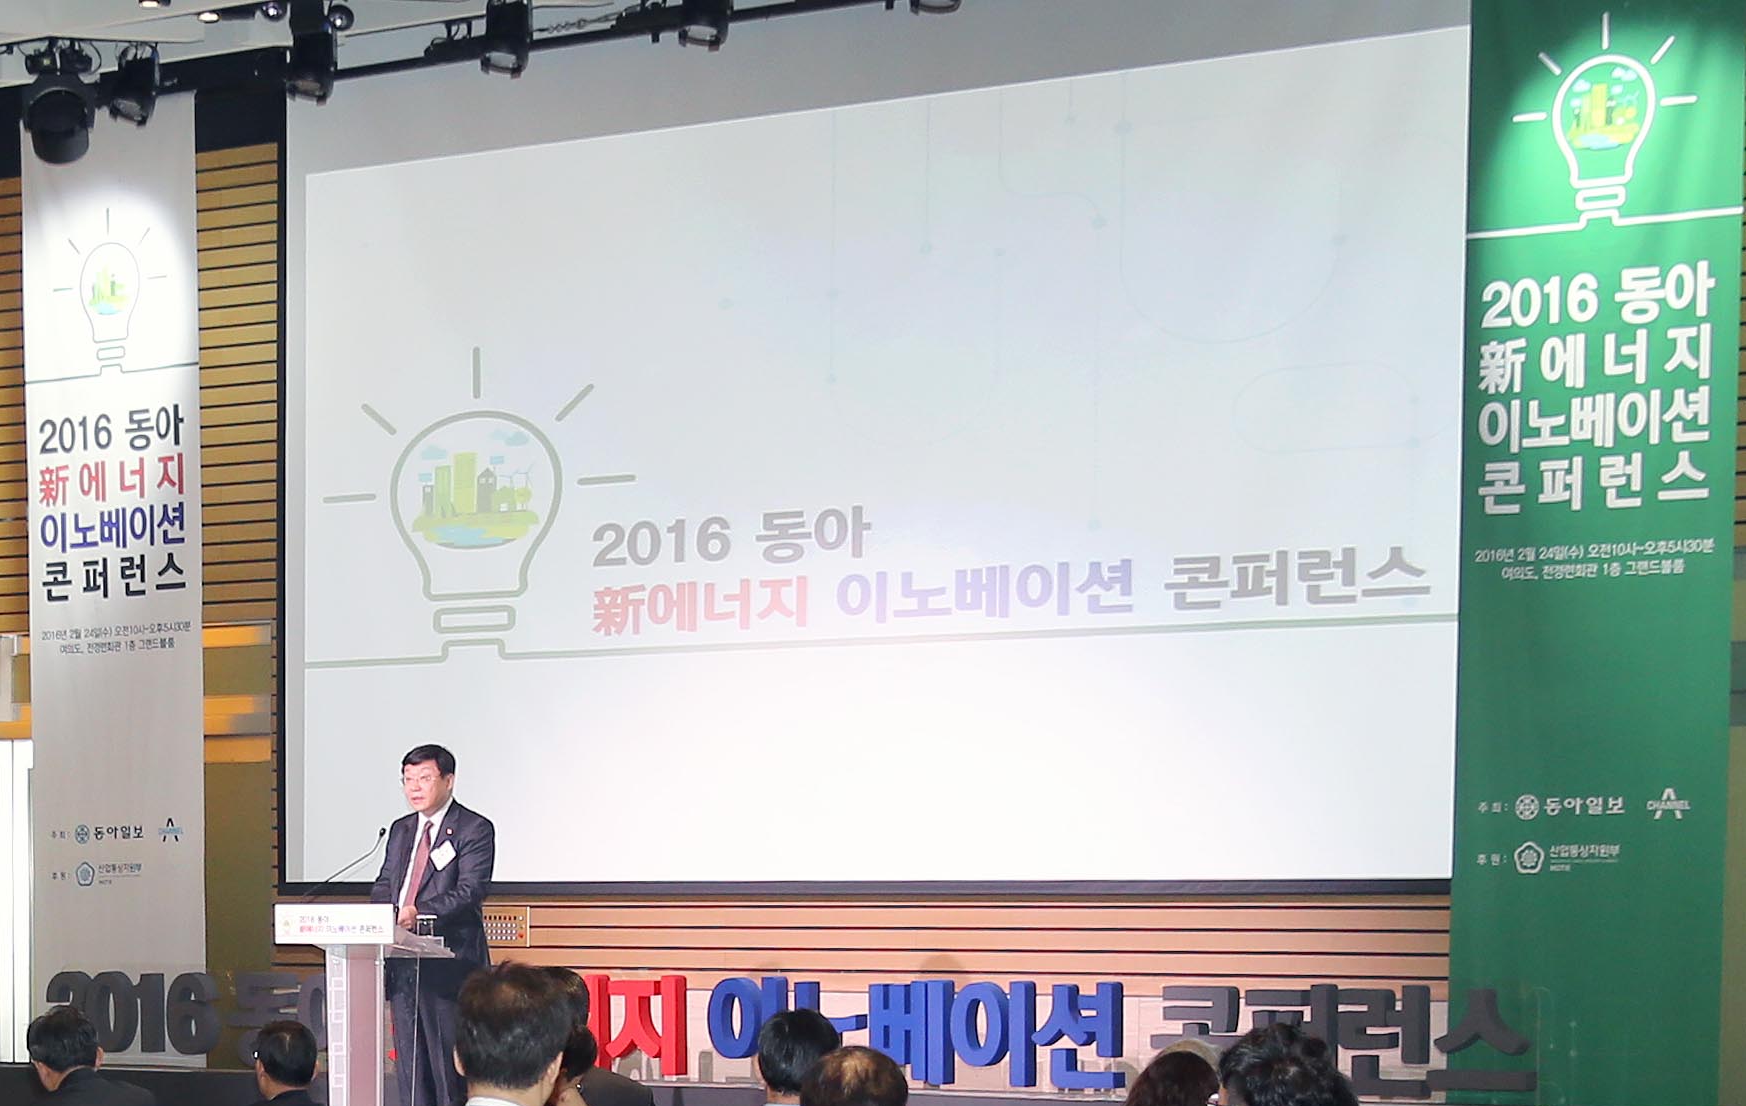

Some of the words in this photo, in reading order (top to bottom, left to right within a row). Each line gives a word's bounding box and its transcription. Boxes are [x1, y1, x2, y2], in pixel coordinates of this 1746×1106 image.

[1481, 272, 1599, 329] 2016
[1613, 259, 1716, 325] 동아
[38, 413, 112, 455] 2016
[124, 403, 185, 451] 동아
[1477, 385, 1711, 454] 이노베이션
[1477, 450, 1710, 515] 콘퍼런스
[40, 501, 186, 554] 이노베이션
[592, 515, 732, 567] 2016
[755, 505, 872, 564] 동아
[42, 552, 187, 603] 콘퍼런스
[591, 575, 809, 636] 新에너지
[836, 558, 1134, 624] 이노베이션
[1163, 546, 1431, 611] 콘퍼런스
[1544, 796, 1626, 816] 동아일보
[1646, 799, 1691, 811] CHANNEL
[93, 825, 145, 841] 동아일보
